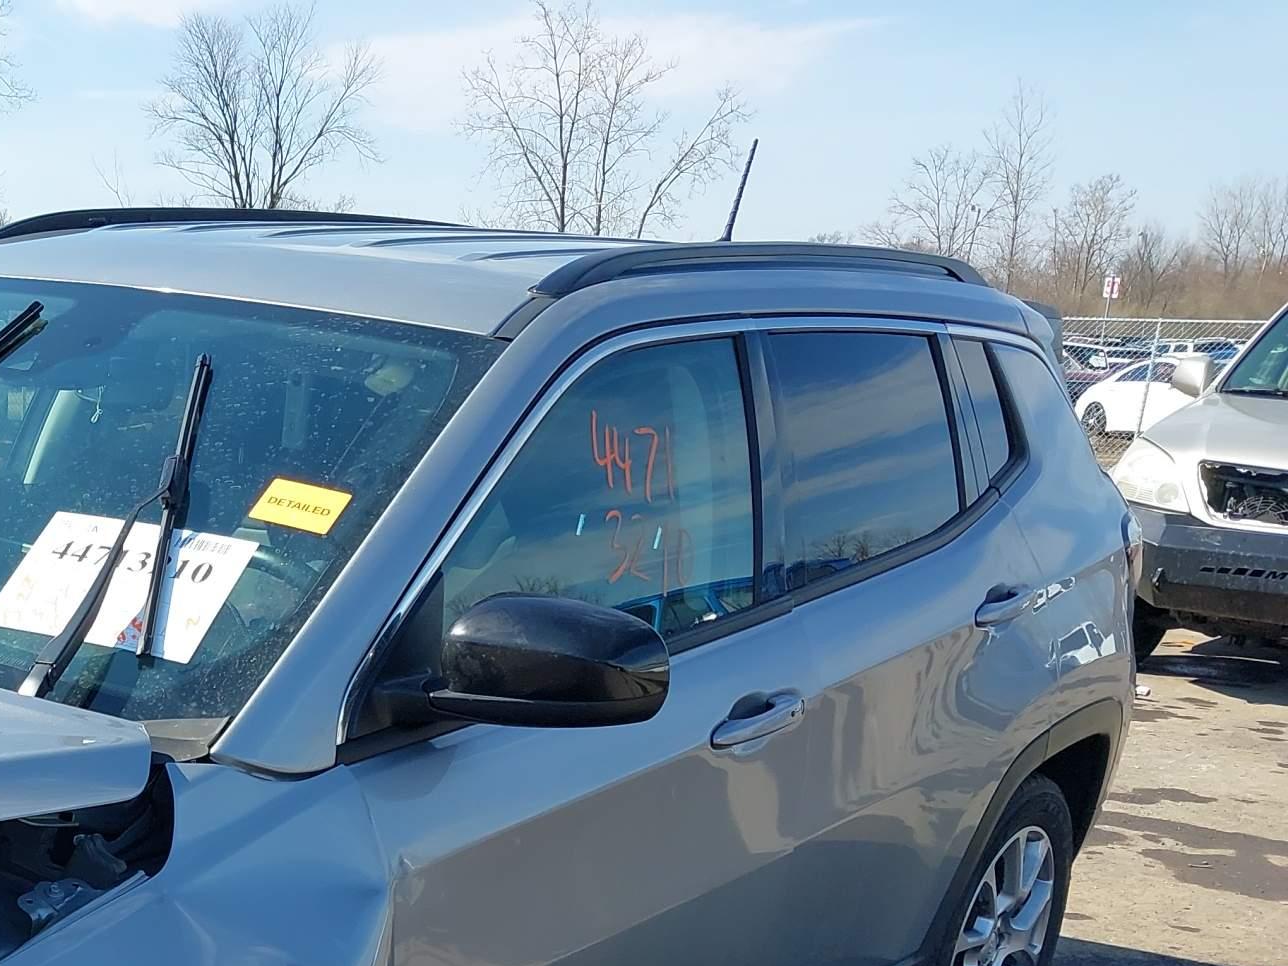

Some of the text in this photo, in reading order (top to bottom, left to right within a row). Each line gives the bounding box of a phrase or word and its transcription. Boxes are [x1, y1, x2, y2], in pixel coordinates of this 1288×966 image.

[591, 410, 675, 503] 4471
[267, 496, 331, 516] DETAILED
[52, 540, 213, 584] 4471310
